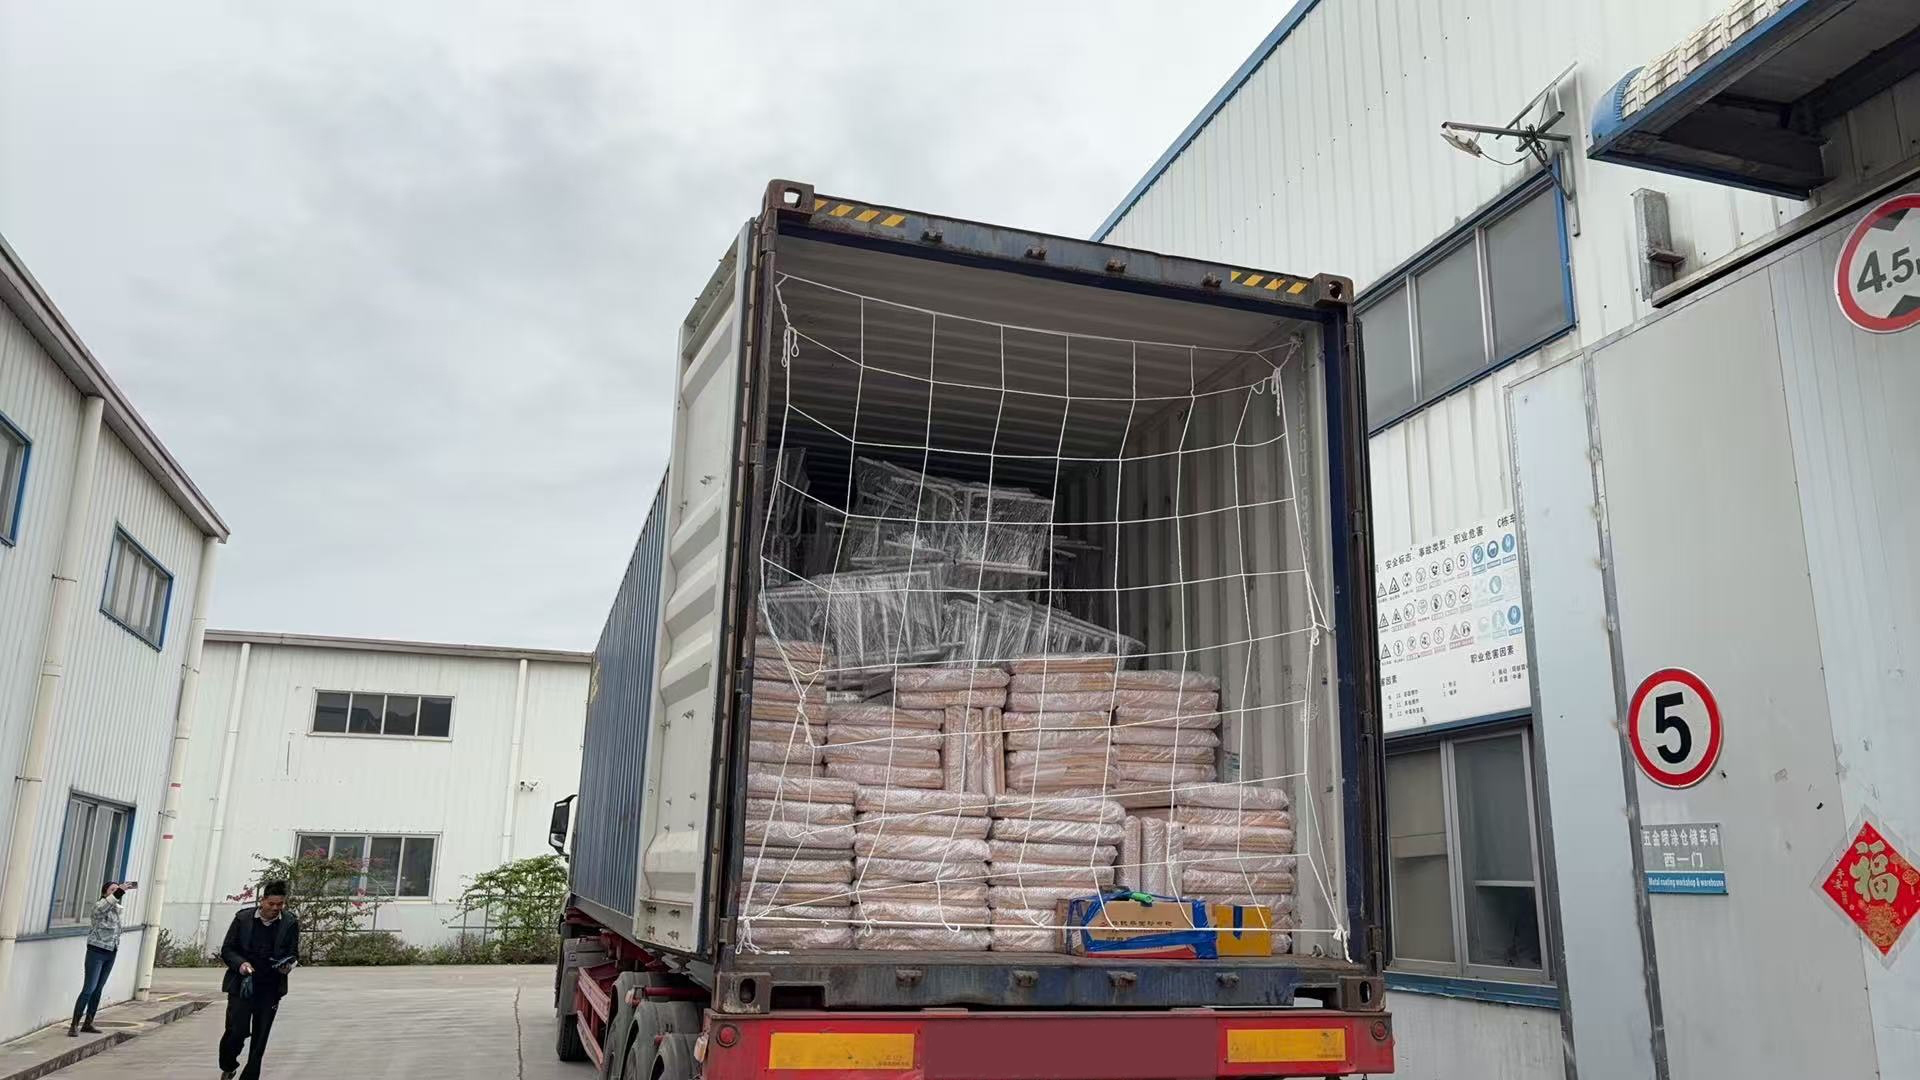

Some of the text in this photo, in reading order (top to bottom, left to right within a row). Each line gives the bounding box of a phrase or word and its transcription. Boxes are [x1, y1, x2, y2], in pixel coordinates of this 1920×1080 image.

[1857, 247, 1920, 293] 4.5
[1459, 555, 1466, 568] 5
[1470, 645, 1514, 663] 职业危害因素
[1655, 691, 1692, 764] 5
[1643, 828, 1719, 847] 五金喷涂仓储车间
[1663, 851, 1703, 868] 西一门
[1849, 839, 1900, 904] 福
[1675, 877, 1696, 888] workshop
[1700, 878, 1724, 887] warehouse
